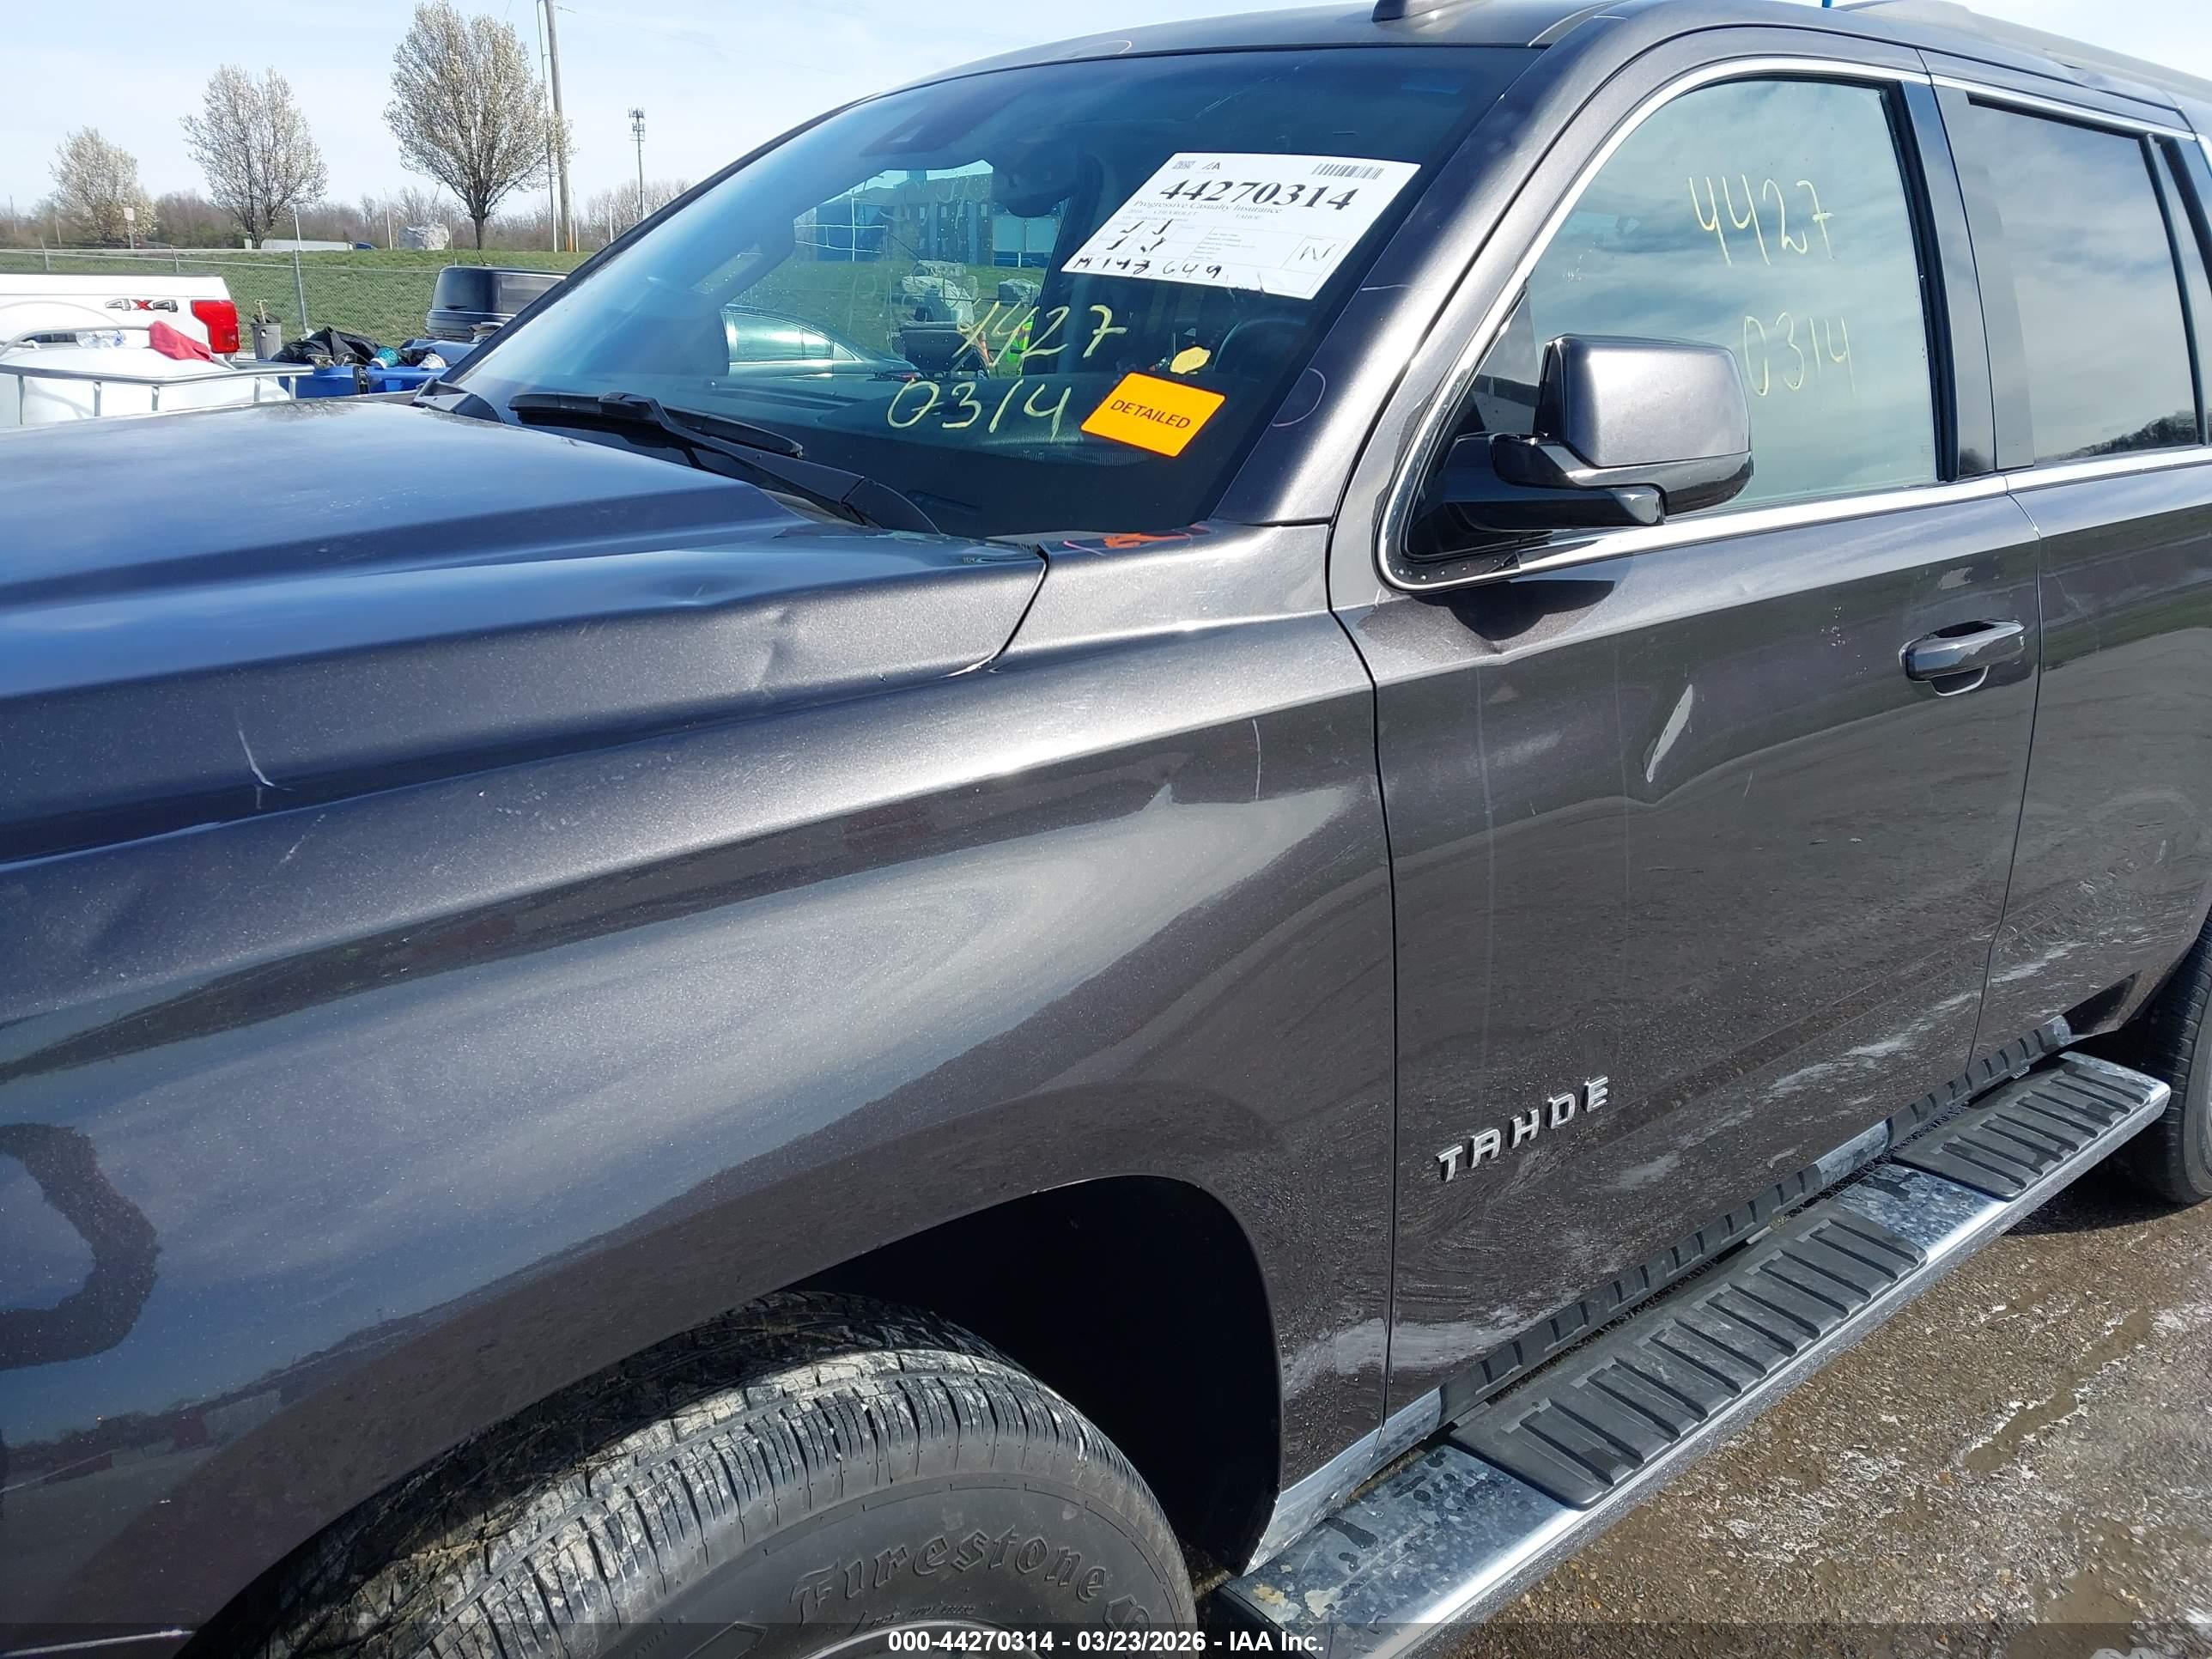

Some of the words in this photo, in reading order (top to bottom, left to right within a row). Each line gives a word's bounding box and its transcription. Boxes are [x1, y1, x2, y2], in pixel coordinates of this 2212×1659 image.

[1133, 199, 1188, 210] Progressive
[1190, 202, 1230, 211] Casualty
[1233, 204, 1283, 215] Insurance
[1159, 179, 1359, 210] 44270314
[1687, 173, 1835, 267] 4427
[1743, 311, 1856, 398] 0314
[887, 378, 1072, 442] 0314
[1109, 398, 1191, 430] DETAILED
[1435, 1074, 1608, 1182] TAHOE
[789, 1525, 1110, 1627] Firestone
